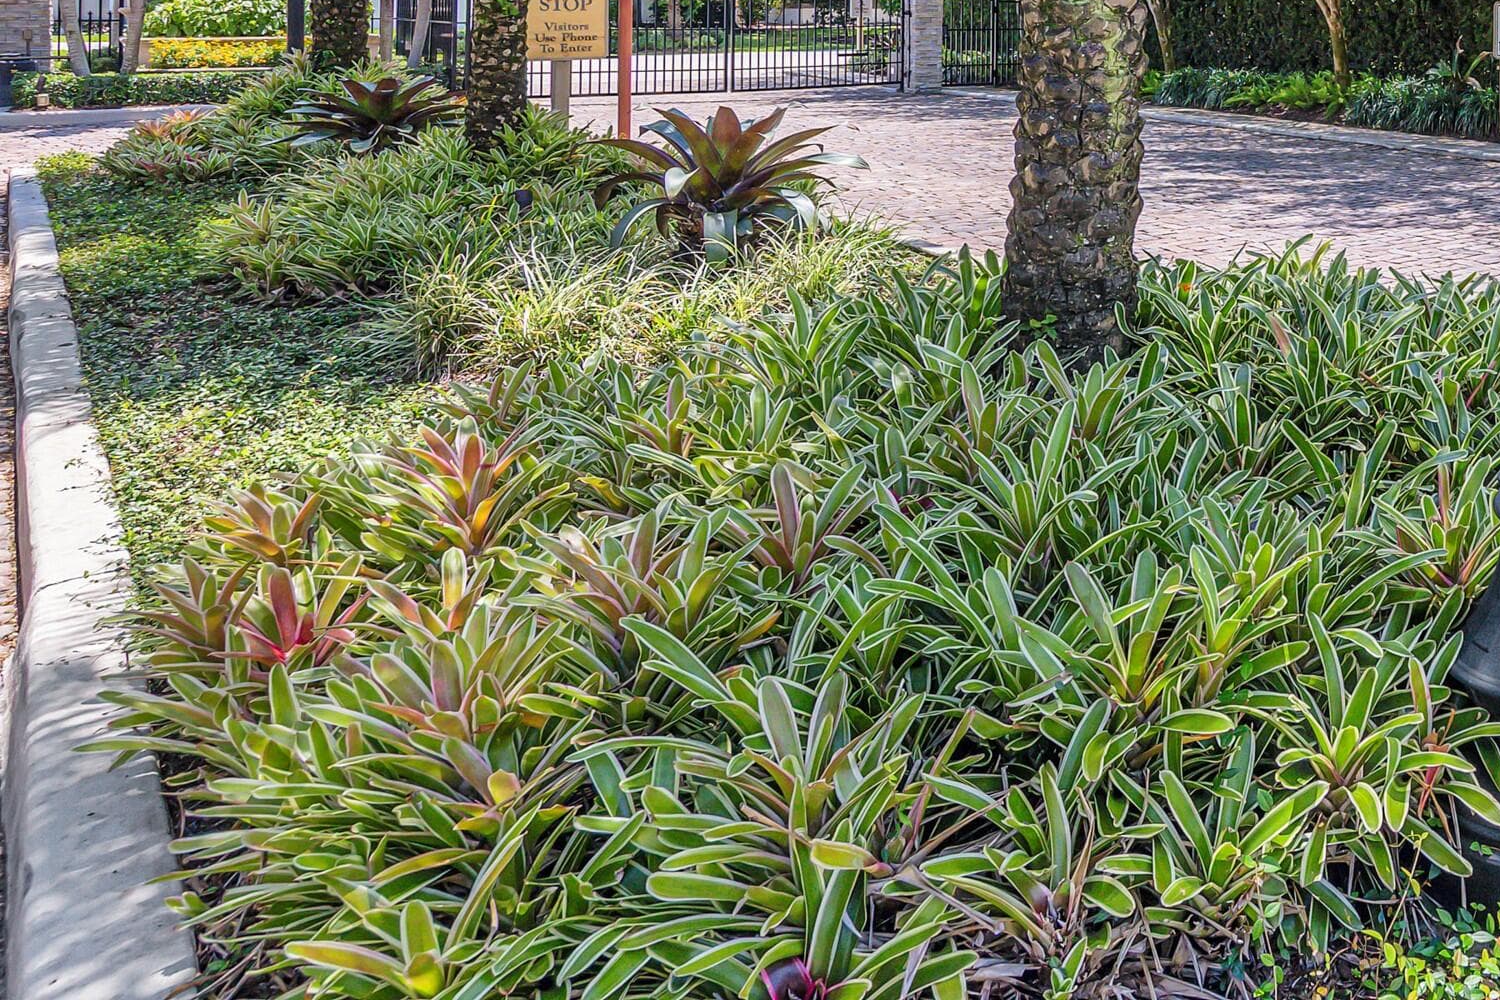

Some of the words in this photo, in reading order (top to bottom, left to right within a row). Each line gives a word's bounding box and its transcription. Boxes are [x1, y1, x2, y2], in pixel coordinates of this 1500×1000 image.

[544, 22, 589, 32] Visitors
[535, 33, 556, 42] Use
[562, 32, 598, 42] Phone
[539, 44, 555, 53] To
[560, 43, 592, 53] Enter
